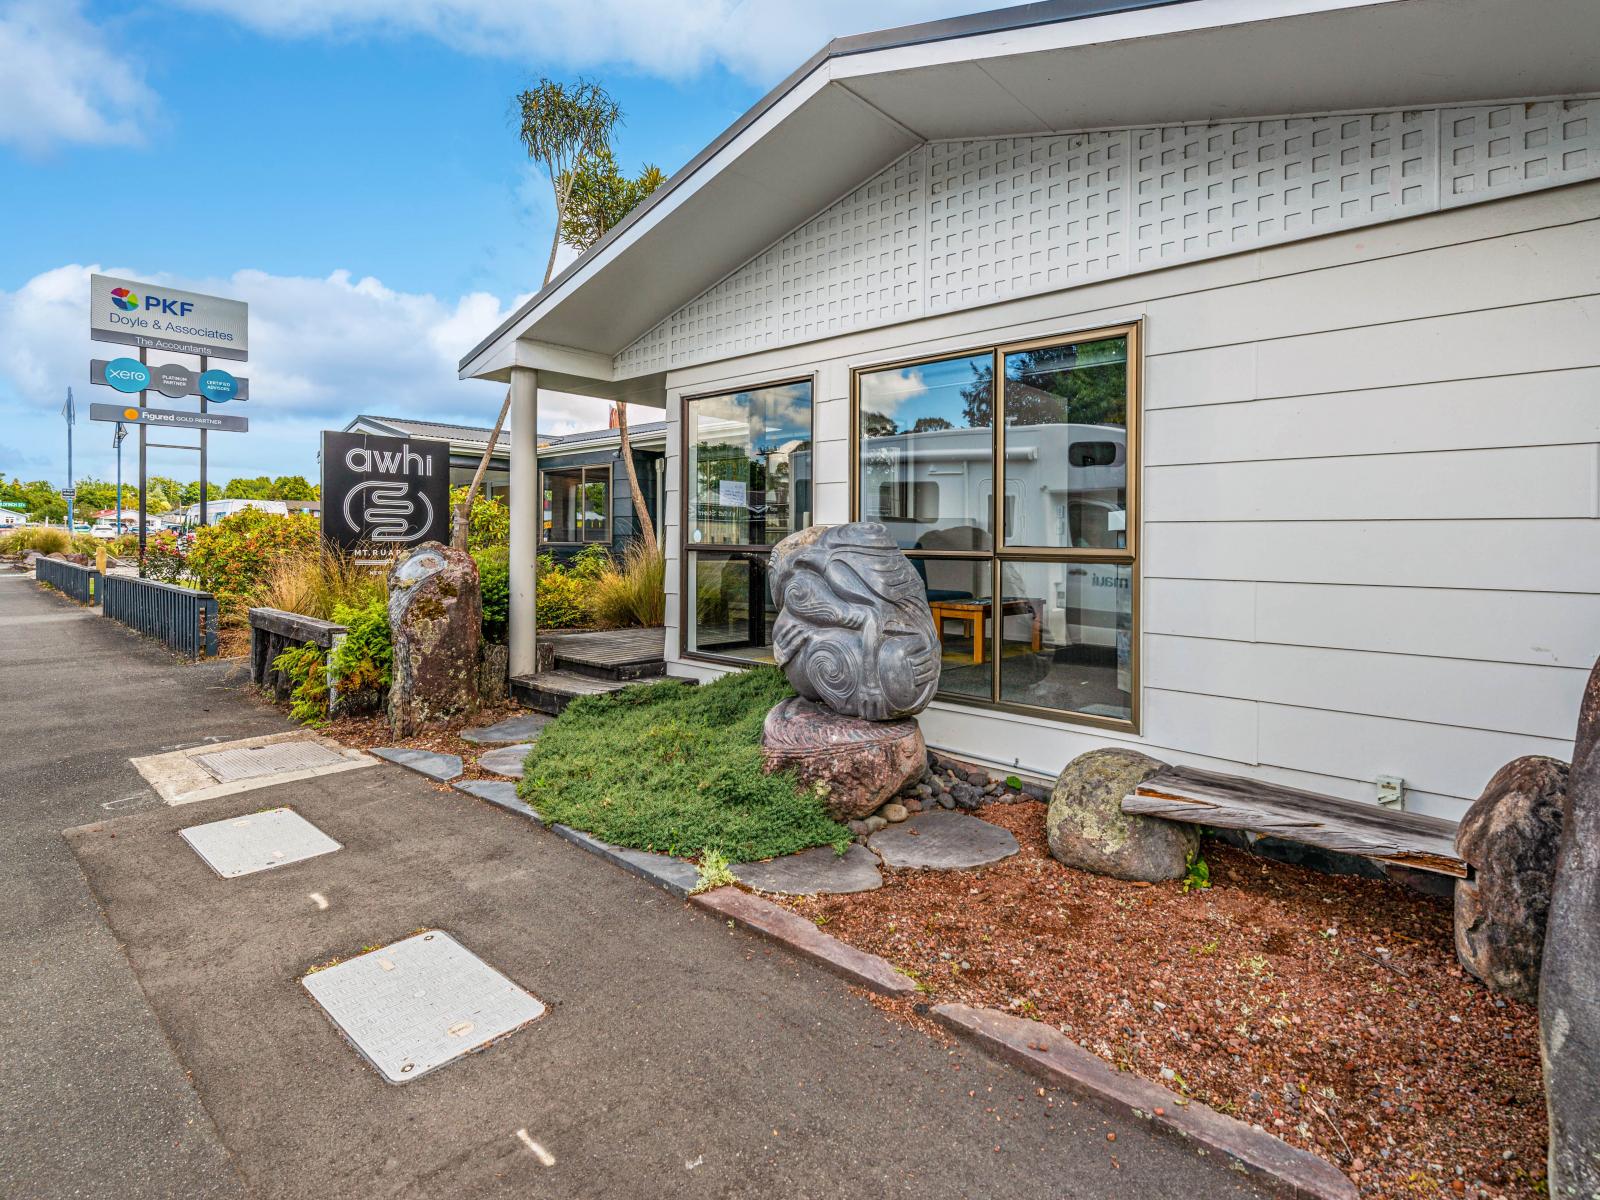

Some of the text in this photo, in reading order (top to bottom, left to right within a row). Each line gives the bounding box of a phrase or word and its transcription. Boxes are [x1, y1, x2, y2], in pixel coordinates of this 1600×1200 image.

[145, 295, 194, 316] PKF
[109, 312, 233, 341] Doyle & Associates
[136, 336, 212, 355] The Accountants
[109, 369, 146, 381] xero
[142, 411, 174, 422] Figured
[195, 417, 222, 425] PARTNER
[345, 444, 432, 476] awhi
